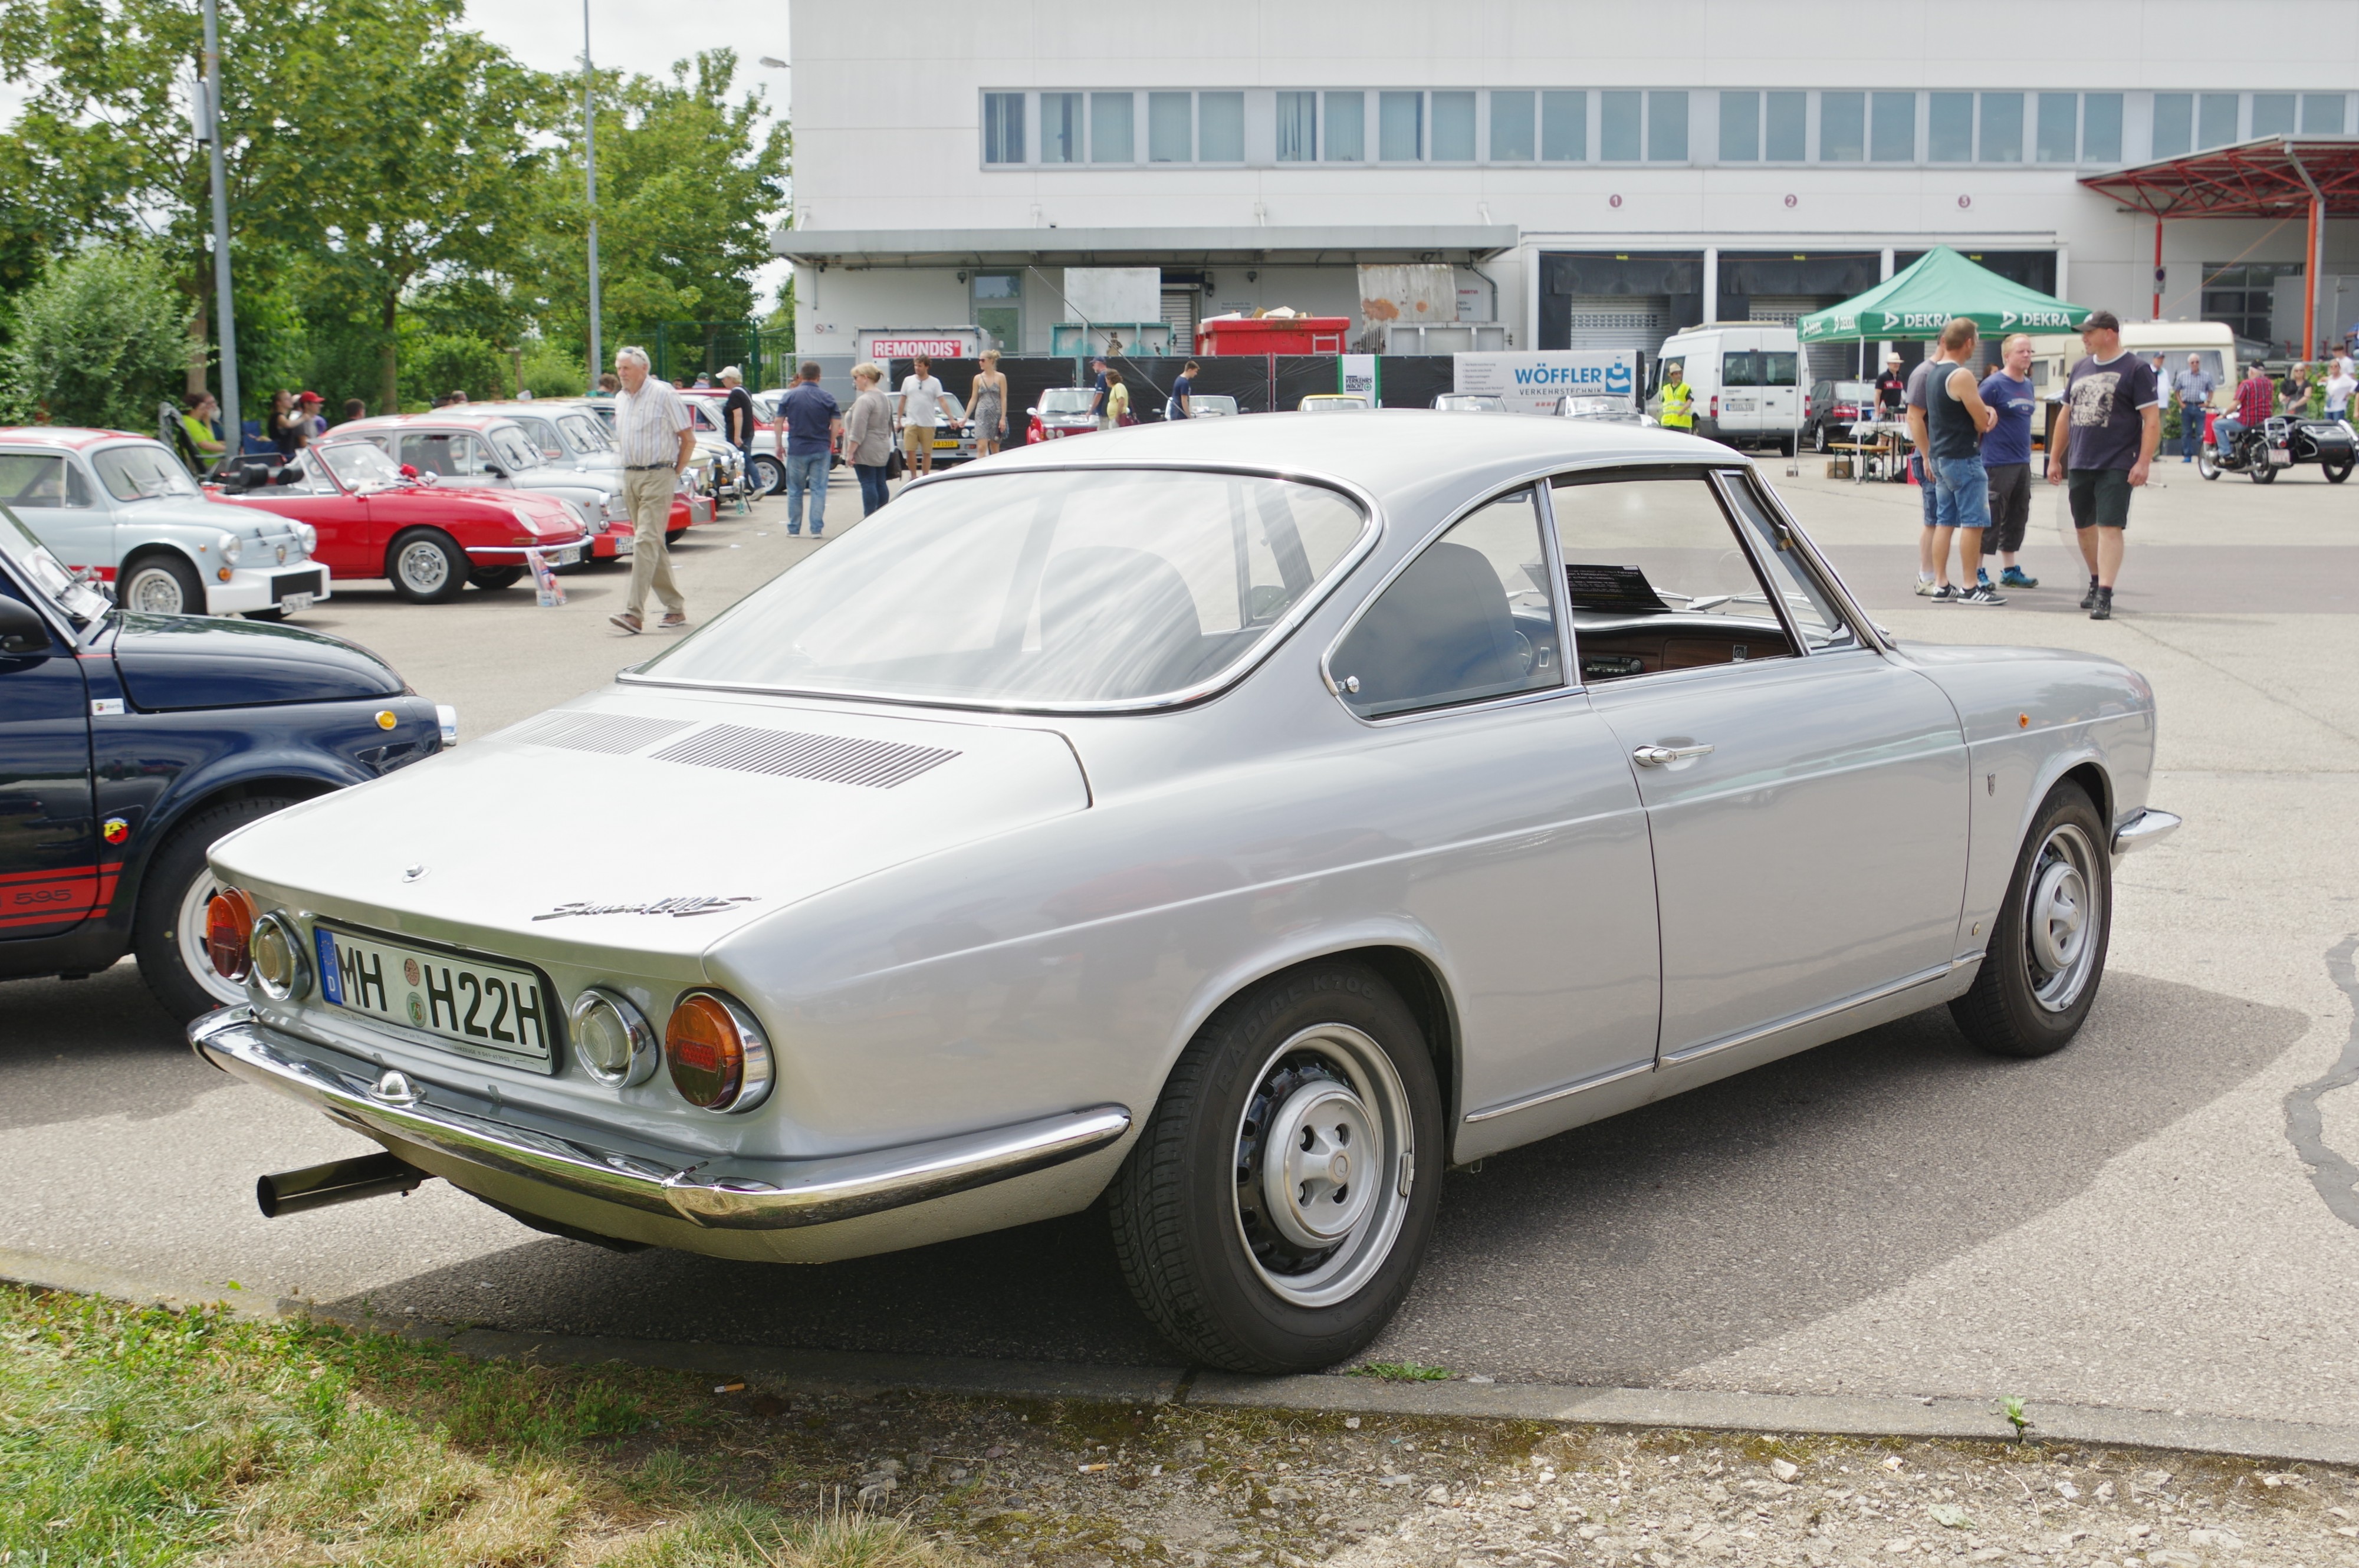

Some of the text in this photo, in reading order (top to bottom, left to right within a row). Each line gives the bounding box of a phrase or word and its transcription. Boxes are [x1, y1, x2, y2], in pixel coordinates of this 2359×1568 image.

[1787, 196, 1794, 206] 2
[1961, 196, 1968, 206] 3
[1904, 313, 1953, 328] DEKRA
[2022, 312, 2071, 327] DEKRA
[874, 341, 954, 357] REMONDIS
[1514, 363, 1602, 384] WÖFFLER
[1519, 387, 1602, 396] VERKEHRSTECHNIK
[14, 889, 73, 905] 595
[327, 975, 336, 992] D
[335, 943, 388, 1013] MH
[1216, 985, 1303, 1094] RADIAL
[1312, 975, 1375, 1000] K706
